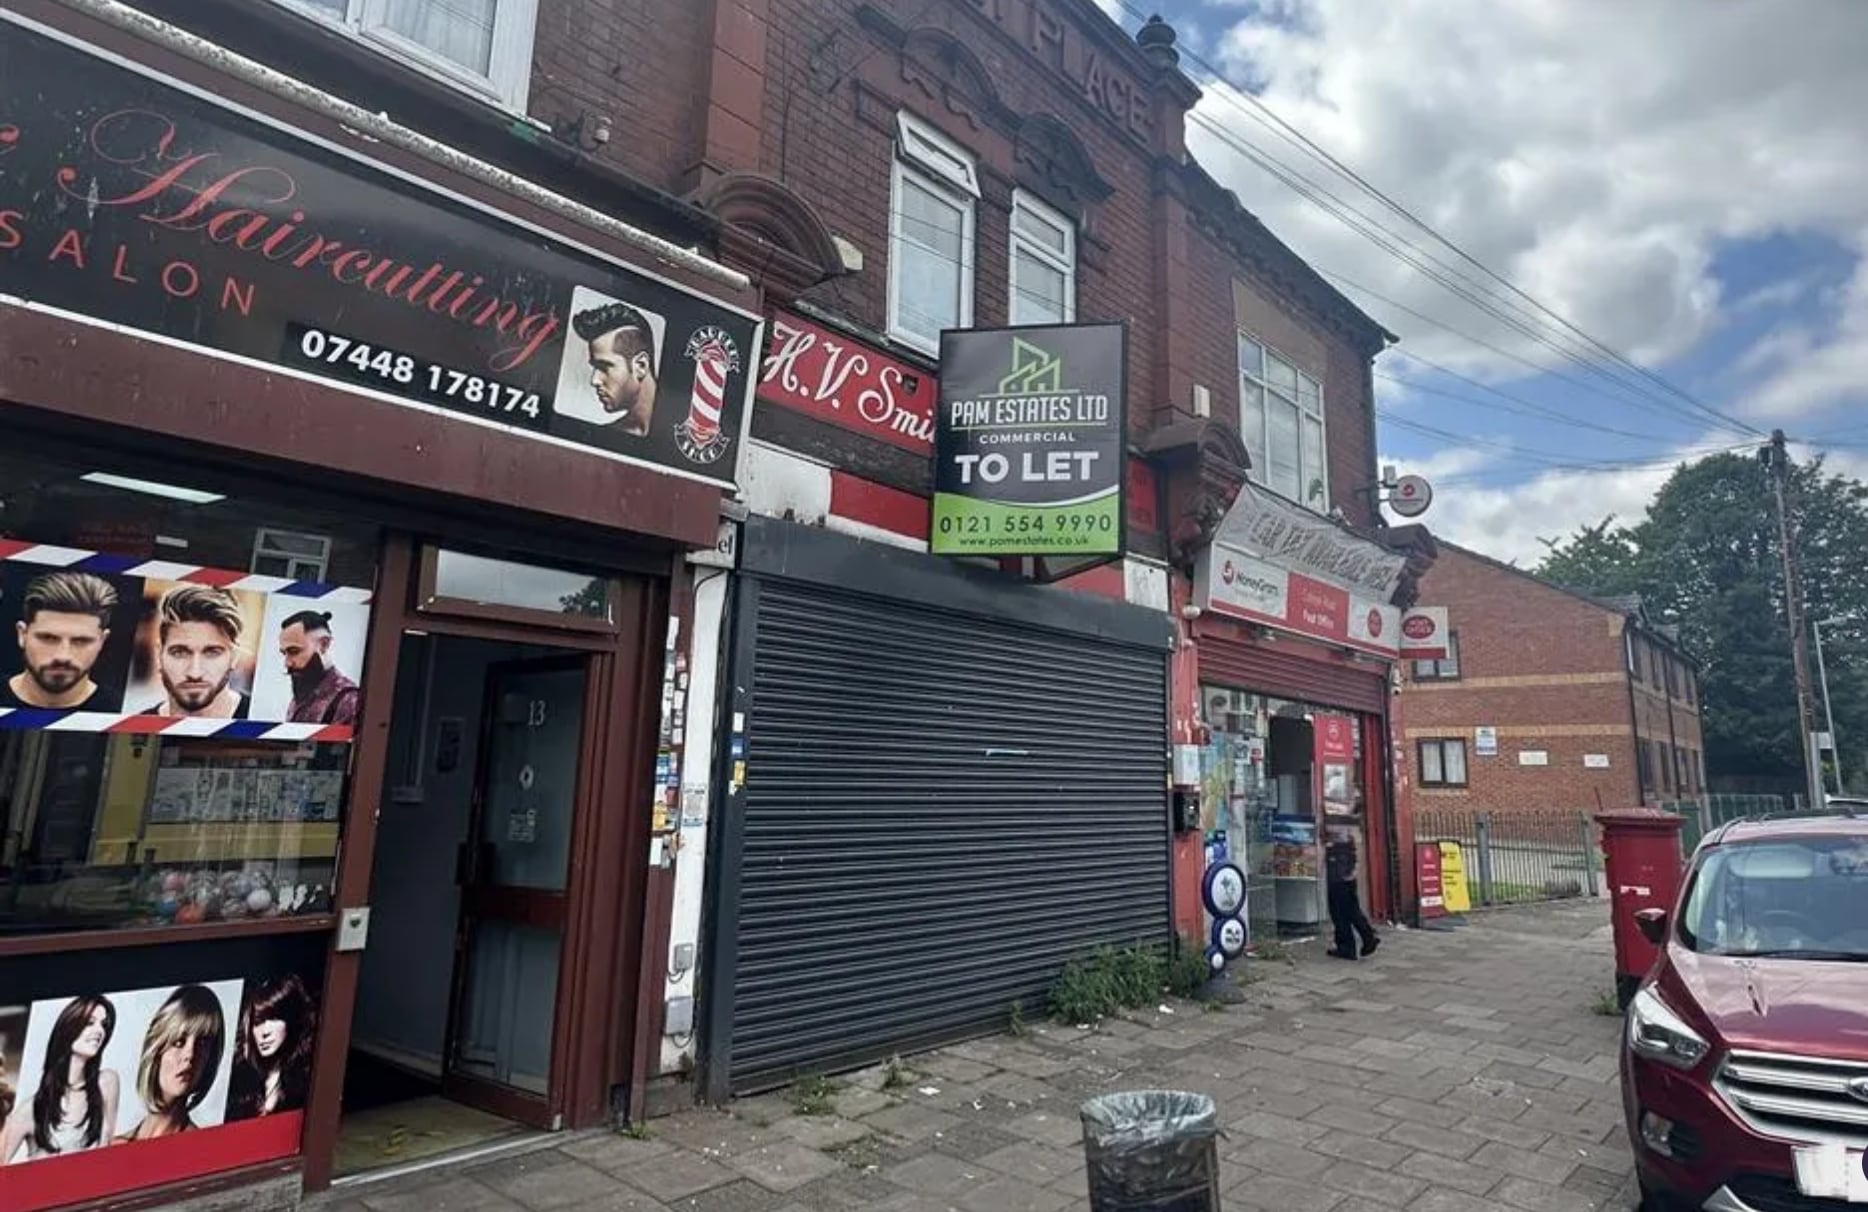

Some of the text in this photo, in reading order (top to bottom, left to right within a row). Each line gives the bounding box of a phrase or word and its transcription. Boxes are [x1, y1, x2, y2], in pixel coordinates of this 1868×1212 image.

[58, 109, 560, 371] Haircutting
[302, 330, 541, 419] 07448 178174
[951, 395, 1108, 425] PAM ESTATES LTD
[979, 431, 1076, 445] COMMERCIAL
[954, 450, 1100, 484] TO LET
[939, 513, 1112, 534] 0121 554 9990
[959, 535, 1089, 548] www.pamestates.co.uk
